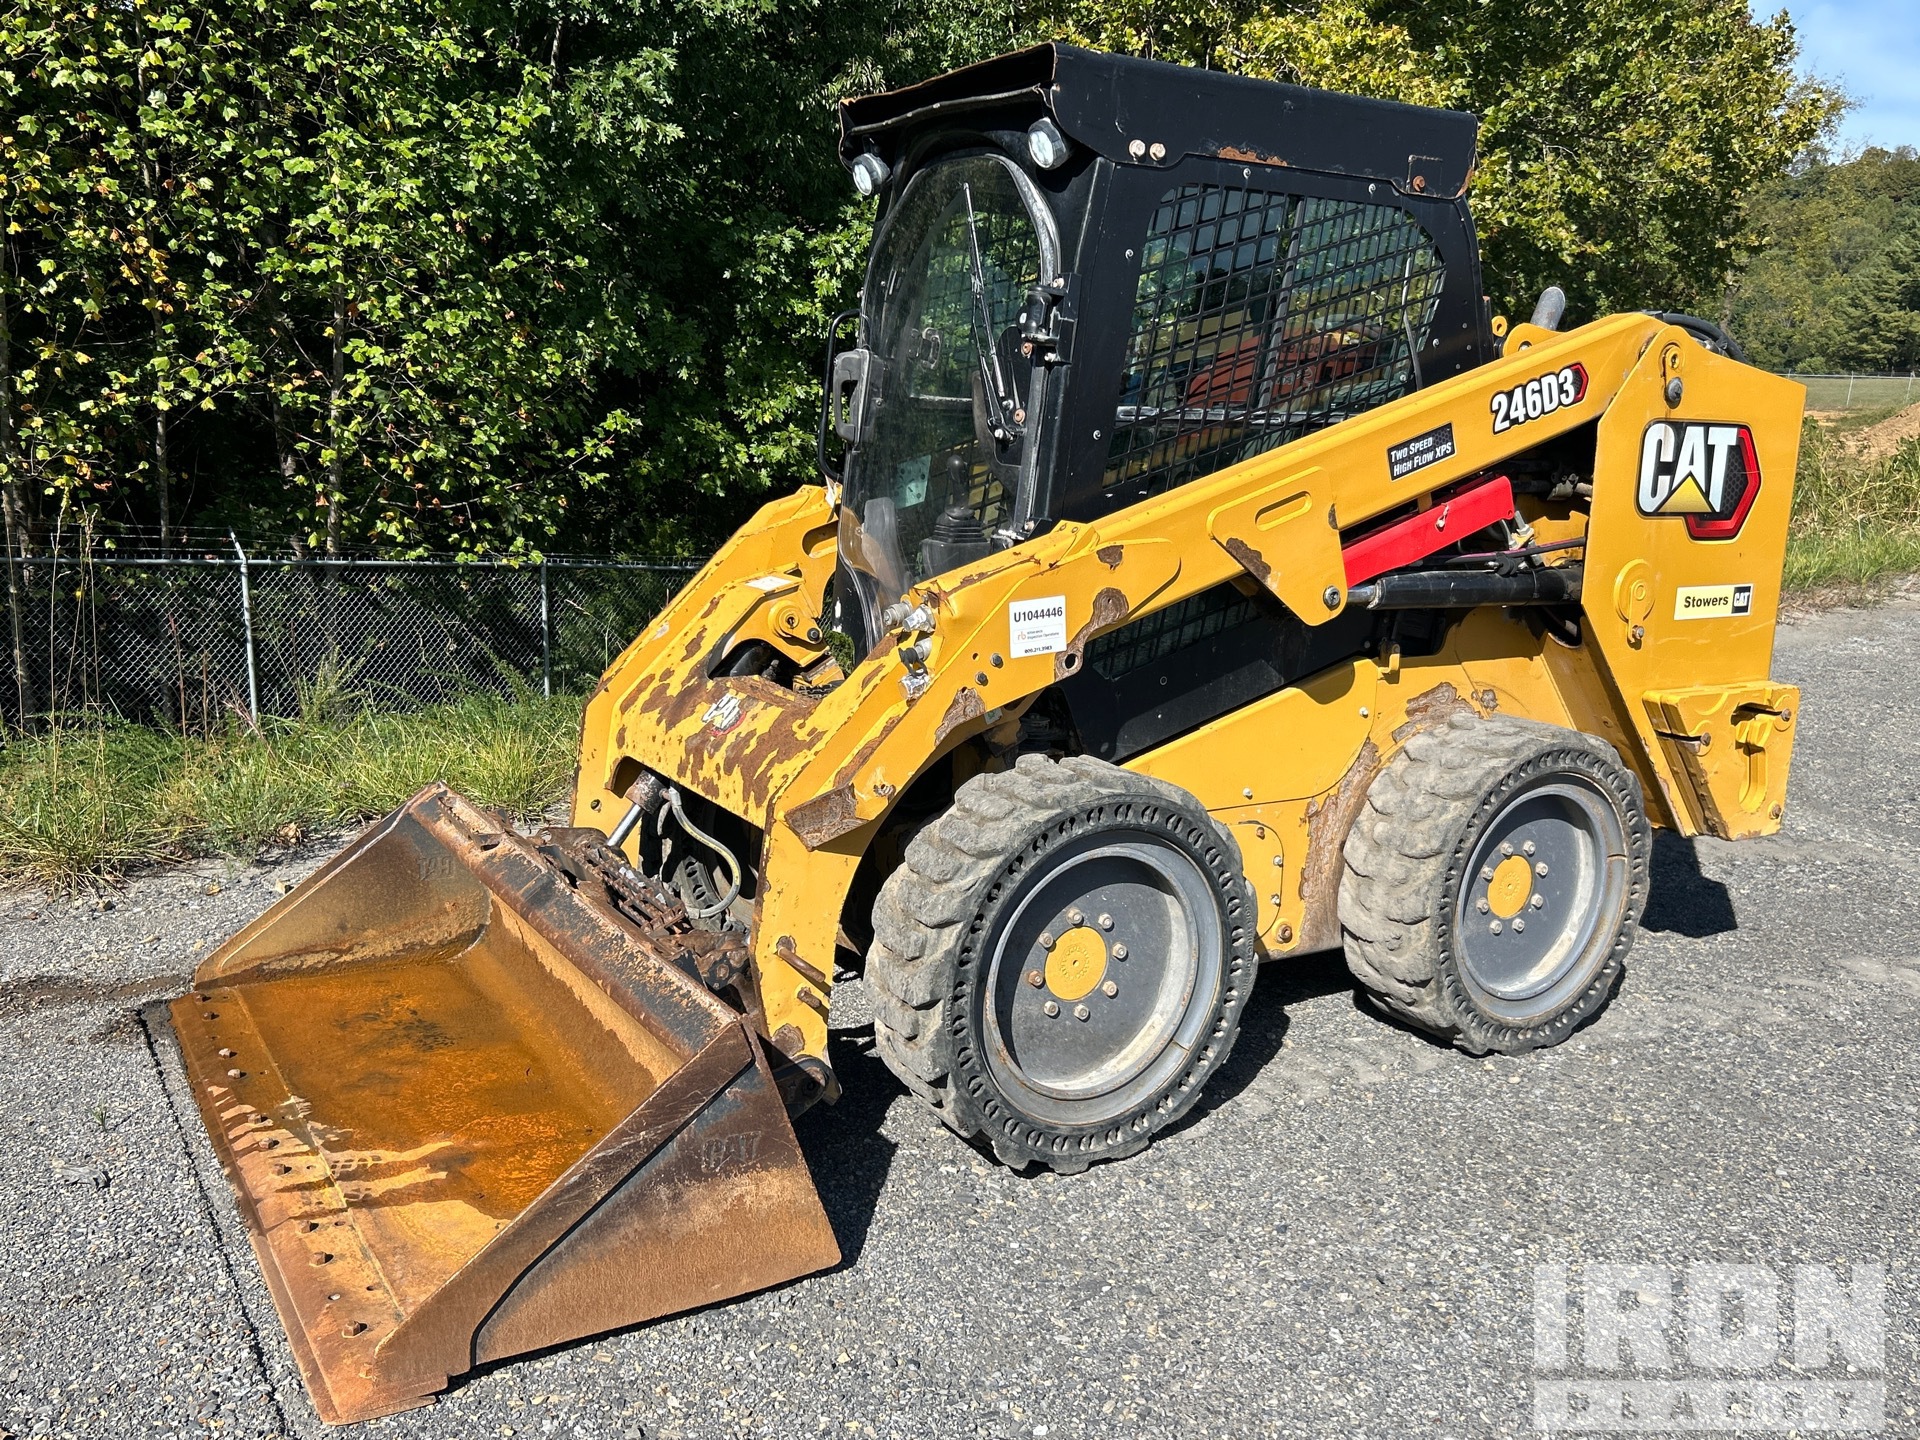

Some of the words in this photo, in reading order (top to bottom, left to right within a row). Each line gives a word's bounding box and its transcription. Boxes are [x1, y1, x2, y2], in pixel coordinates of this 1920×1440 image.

[1491, 367, 1575, 433] 246D3
[1391, 447, 1408, 463] TWO
[1409, 437, 1433, 455] SPEED
[1393, 460, 1412, 477] HIGH
[1414, 451, 1434, 468] FLOW
[1435, 442, 1452, 459] XPS
[1639, 423, 1738, 513] CAT
[1013, 606, 1063, 623] U1044446
[1683, 595, 1729, 609] Stowers
[1733, 592, 1751, 607] CAT
